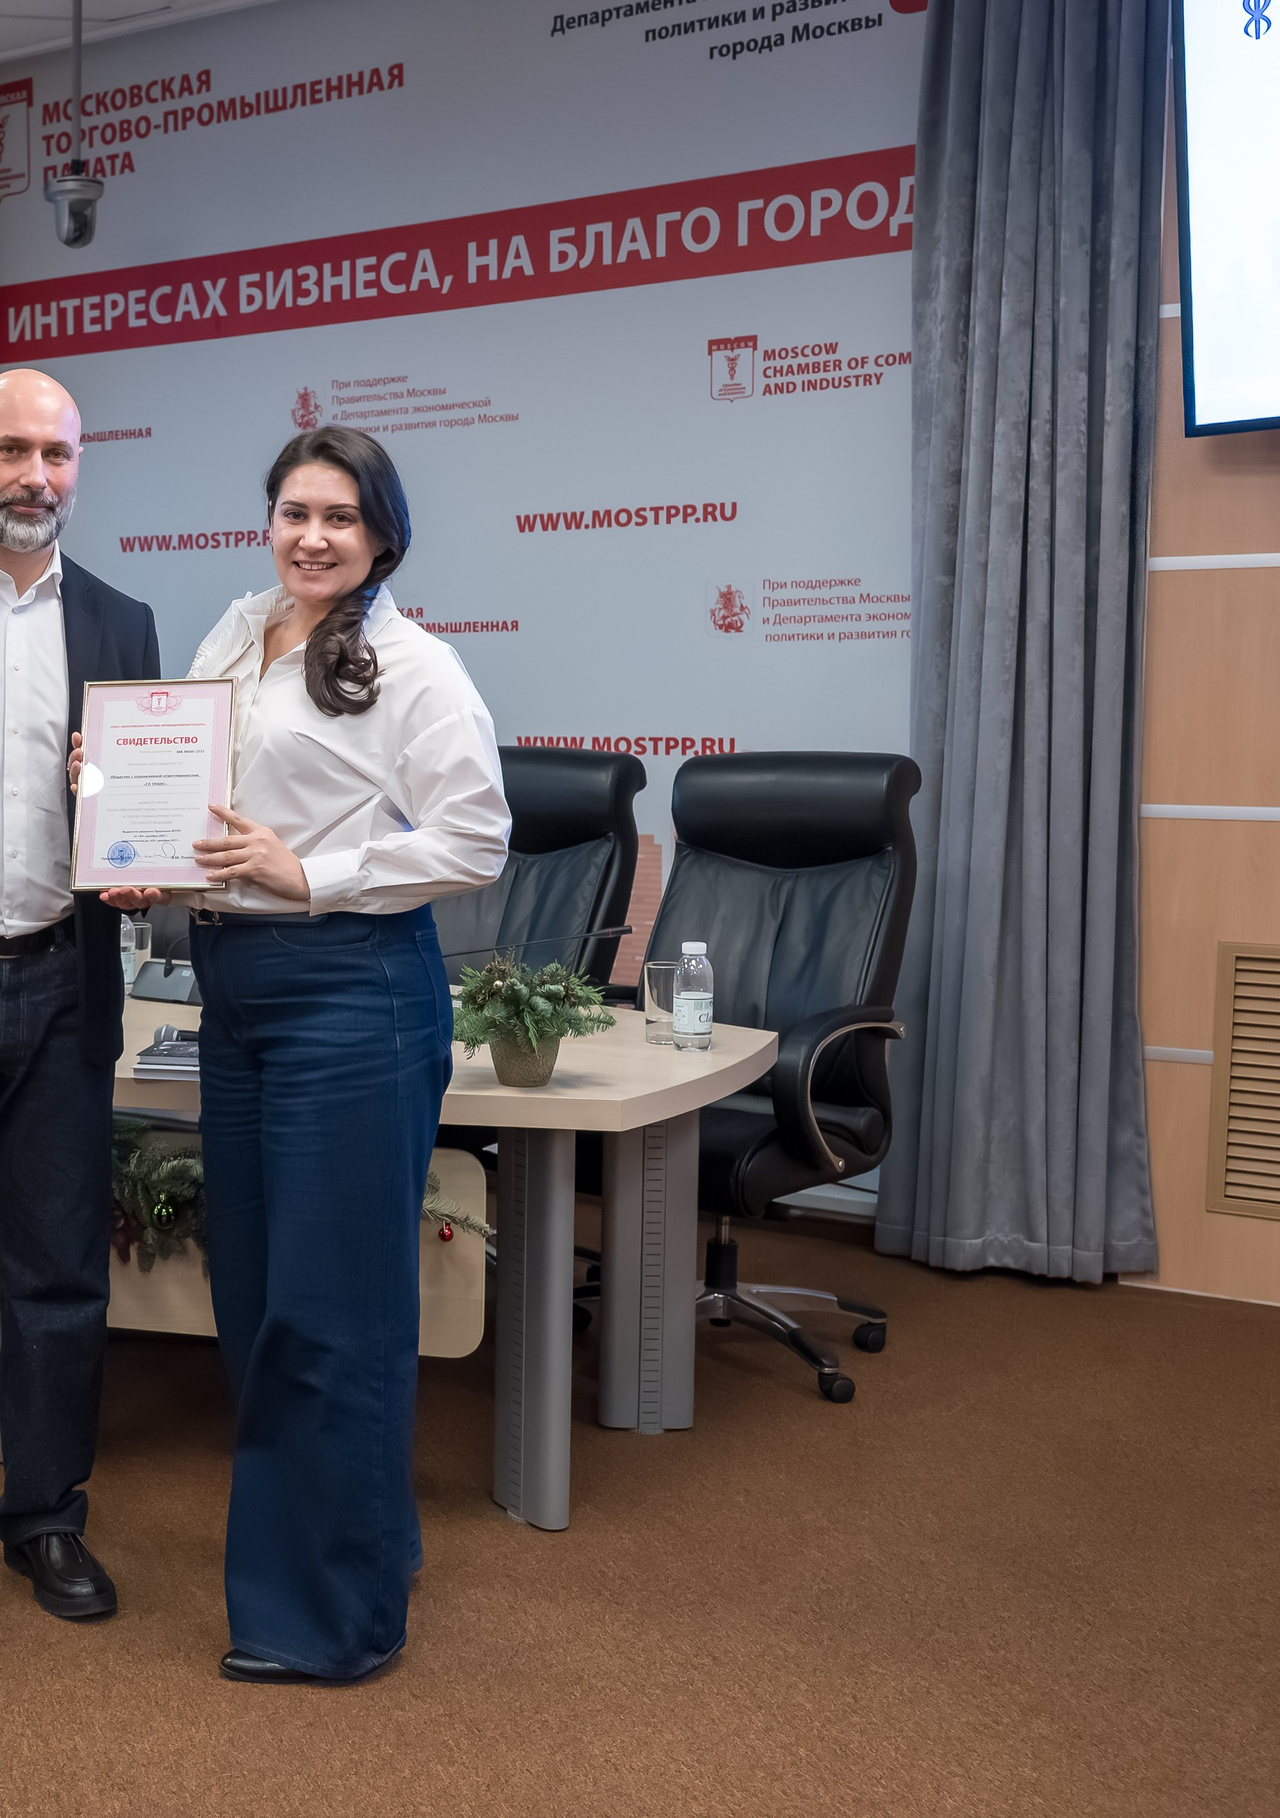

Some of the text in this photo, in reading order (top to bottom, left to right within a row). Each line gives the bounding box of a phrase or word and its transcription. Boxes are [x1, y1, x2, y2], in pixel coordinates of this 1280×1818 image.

[551, 0, 697, 37] Департамен
[644, 0, 846, 43] политики и разв
[709, 13, 883, 60] города Москвы
[8, 278, 227, 343] ИНТЕРЕСАХ
[239, 249, 453, 314] БИЗНЕСА,
[468, 234, 534, 284] НА
[549, 207, 720, 273] БЛАГО
[763, 342, 839, 362] MOSCOW
[762, 359, 843, 379] CHAMBER
[847, 356, 869, 371] OF
[331, 374, 408, 392] При поддержке
[762, 381, 797, 396] AND
[801, 372, 884, 392] INDUSTRY
[332, 386, 447, 407] Правительства Москвы
[340, 406, 409, 421] Департамента
[411, 396, 492, 415] экономической
[391, 420, 437, 434] развития
[439, 417, 476, 430] города
[477, 412, 519, 424] Москвы
[516, 502, 738, 533] WWW.MOSTPP.RU
[762, 577, 861, 592] При поддержке
[762, 593, 911, 610] Правительства Москвы
[762, 617, 769, 625] и
[772, 612, 862, 627] Департамента
[765, 631, 824, 642] политики
[827, 632, 835, 641] и
[838, 629, 897, 643] развития
[116, 736, 198, 746] СВИДЕТЕЛЬСТВО
[516, 736, 736, 756] WWWMOSTPP.RU
